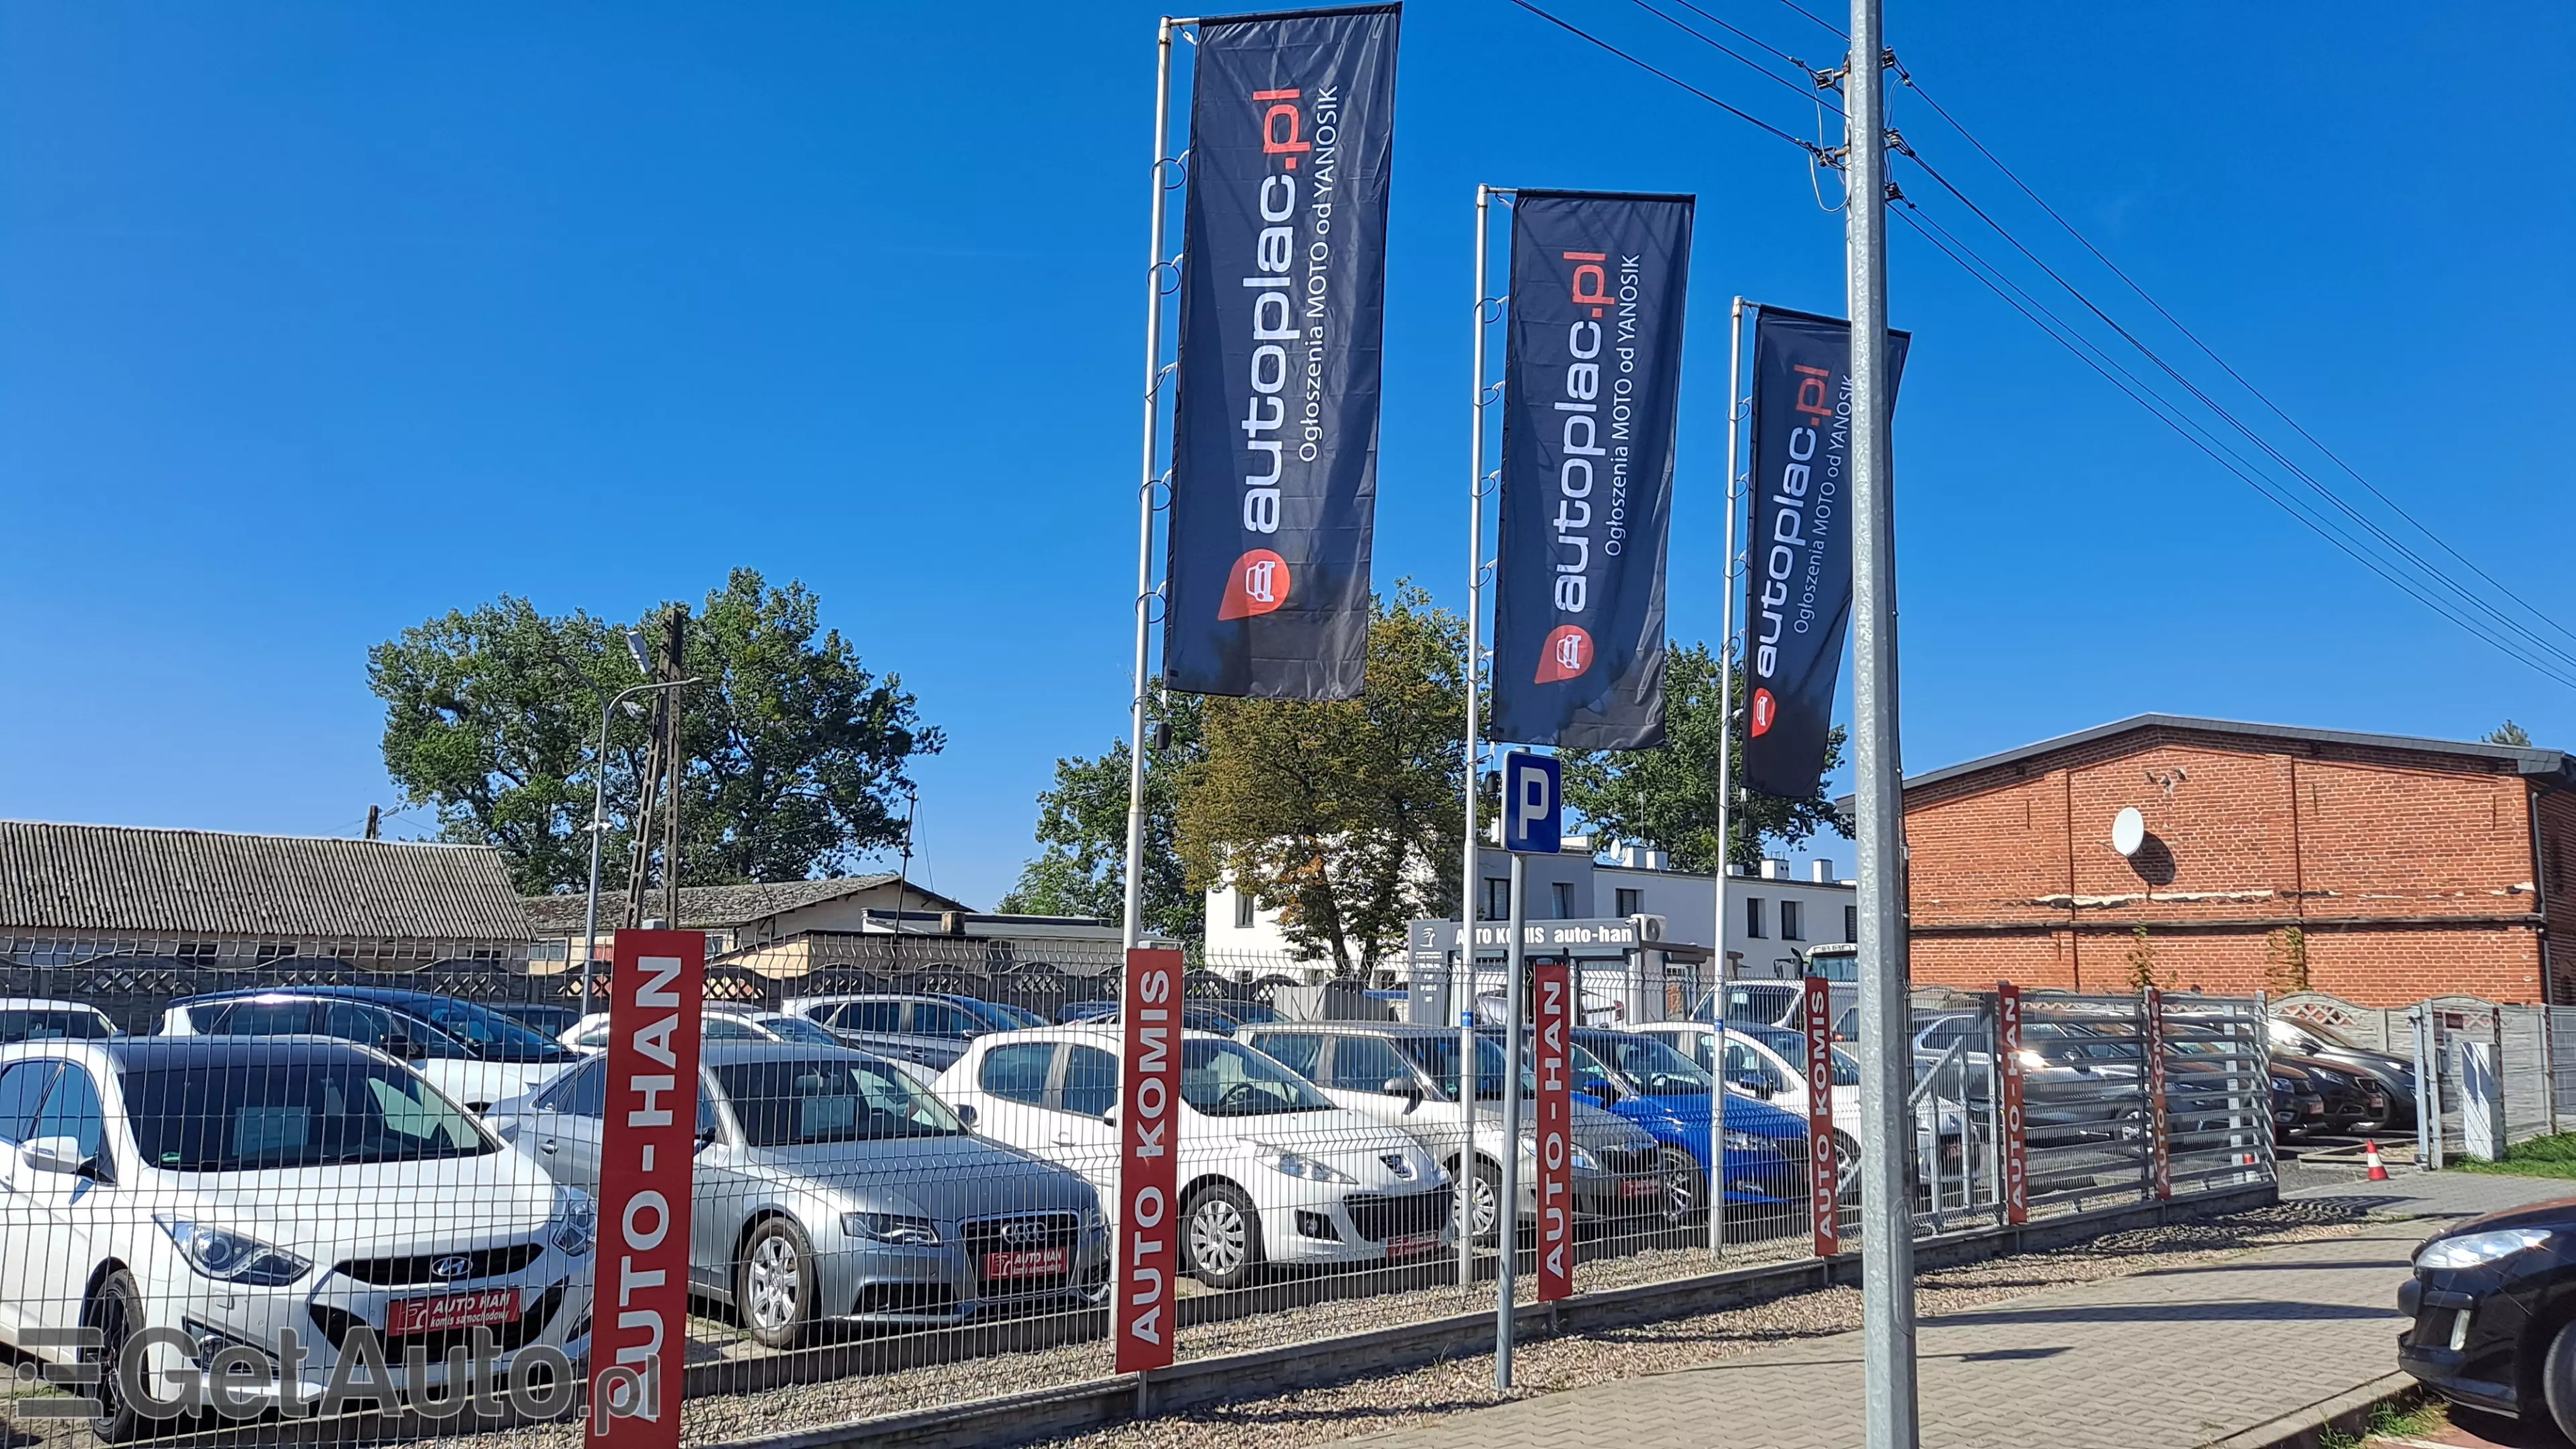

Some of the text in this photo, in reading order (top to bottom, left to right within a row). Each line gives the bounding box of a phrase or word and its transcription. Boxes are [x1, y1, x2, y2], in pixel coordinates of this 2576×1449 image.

[1242, 89, 1311, 534] autoplac.pl
[1299, 85, 1338, 462] Ogłoszenia MOTO od YANOSIK
[1605, 254, 1640, 556] Ogłoszenia MOTO od YANOSIK
[1553, 252, 1615, 613] autoplac.pl
[1757, 364, 1832, 679] autoplac.pl
[1793, 539, 1825, 633] Ogłoszenia
[1812, 482, 1836, 535] MOTO
[1826, 454, 1841, 478] od
[1455, 928, 1492, 945] ATO
[1554, 926, 1633, 943] auto-han
[1519, 766, 1550, 840] P
[1132, 969, 1169, 1345] AUTO KOMIS
[1811, 991, 1833, 1240] AUTO KOMIS
[2157, 1108, 2168, 1187] AUTO
[432, 1293, 511, 1314] AUTO HAN
